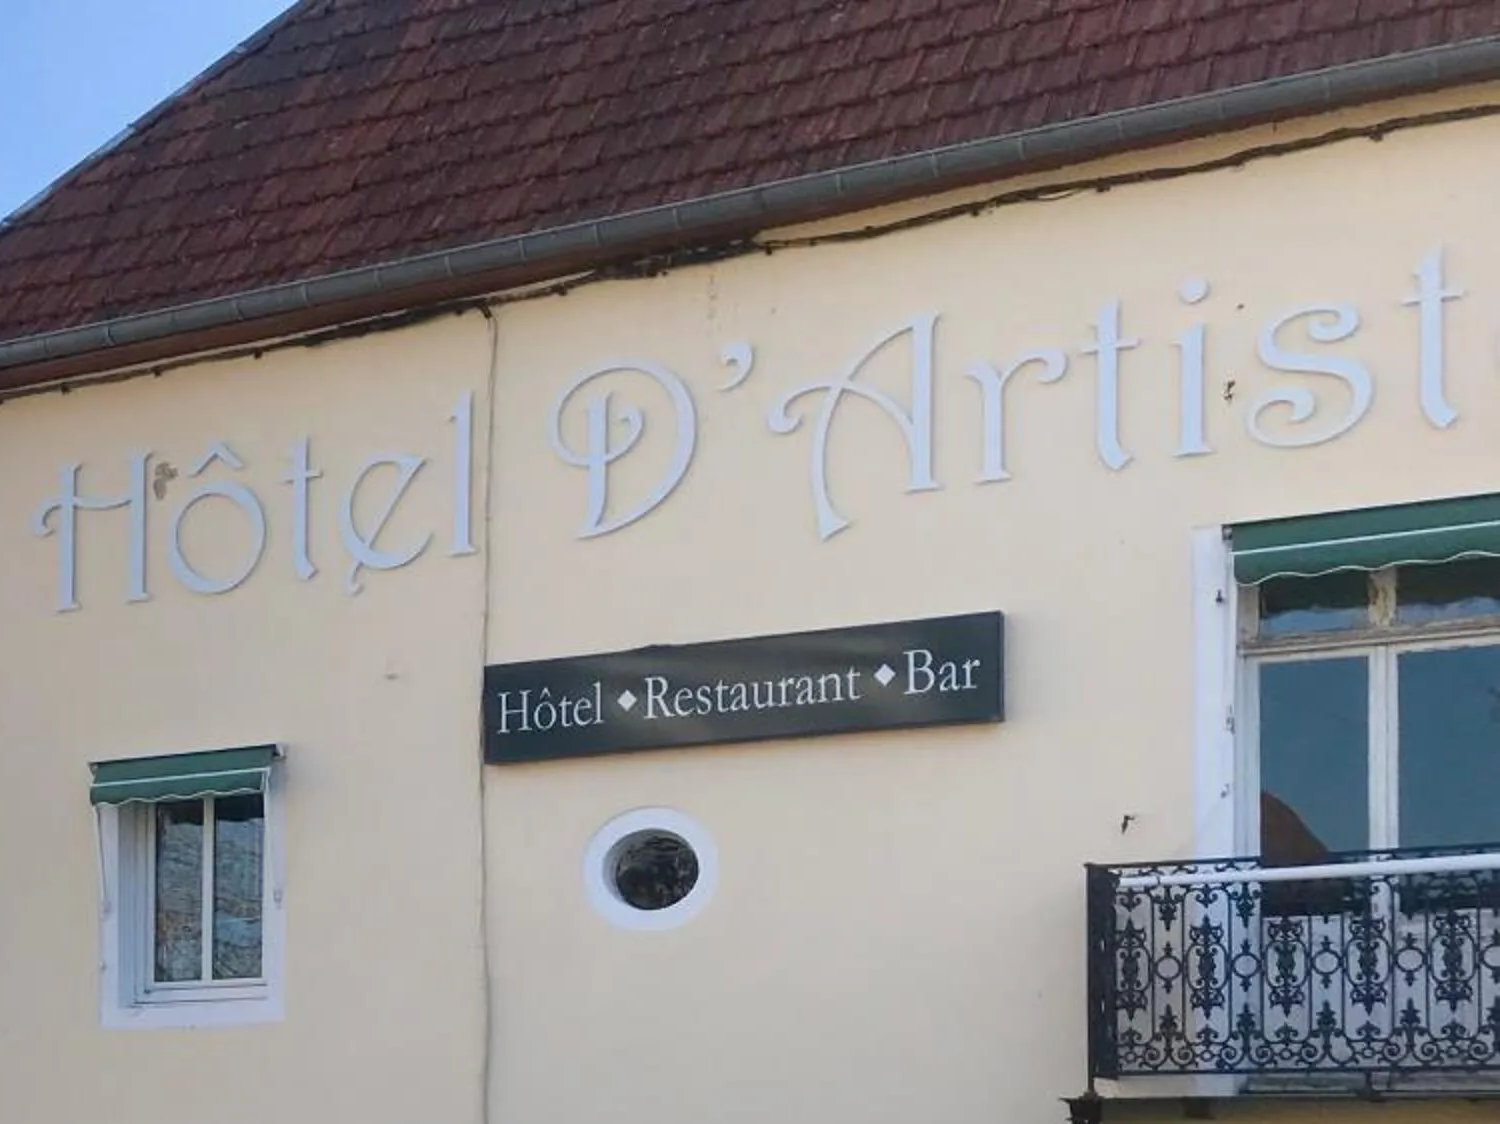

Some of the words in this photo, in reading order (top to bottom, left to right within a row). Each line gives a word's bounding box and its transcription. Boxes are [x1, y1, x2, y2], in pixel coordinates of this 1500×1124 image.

[30, 392, 477, 613] Hôtel
[547, 243, 1500, 541] D'Artist
[497, 682, 605, 734] Hôtel
[643, 663, 861, 720] Restaurant
[903, 648, 981, 696] Bar
